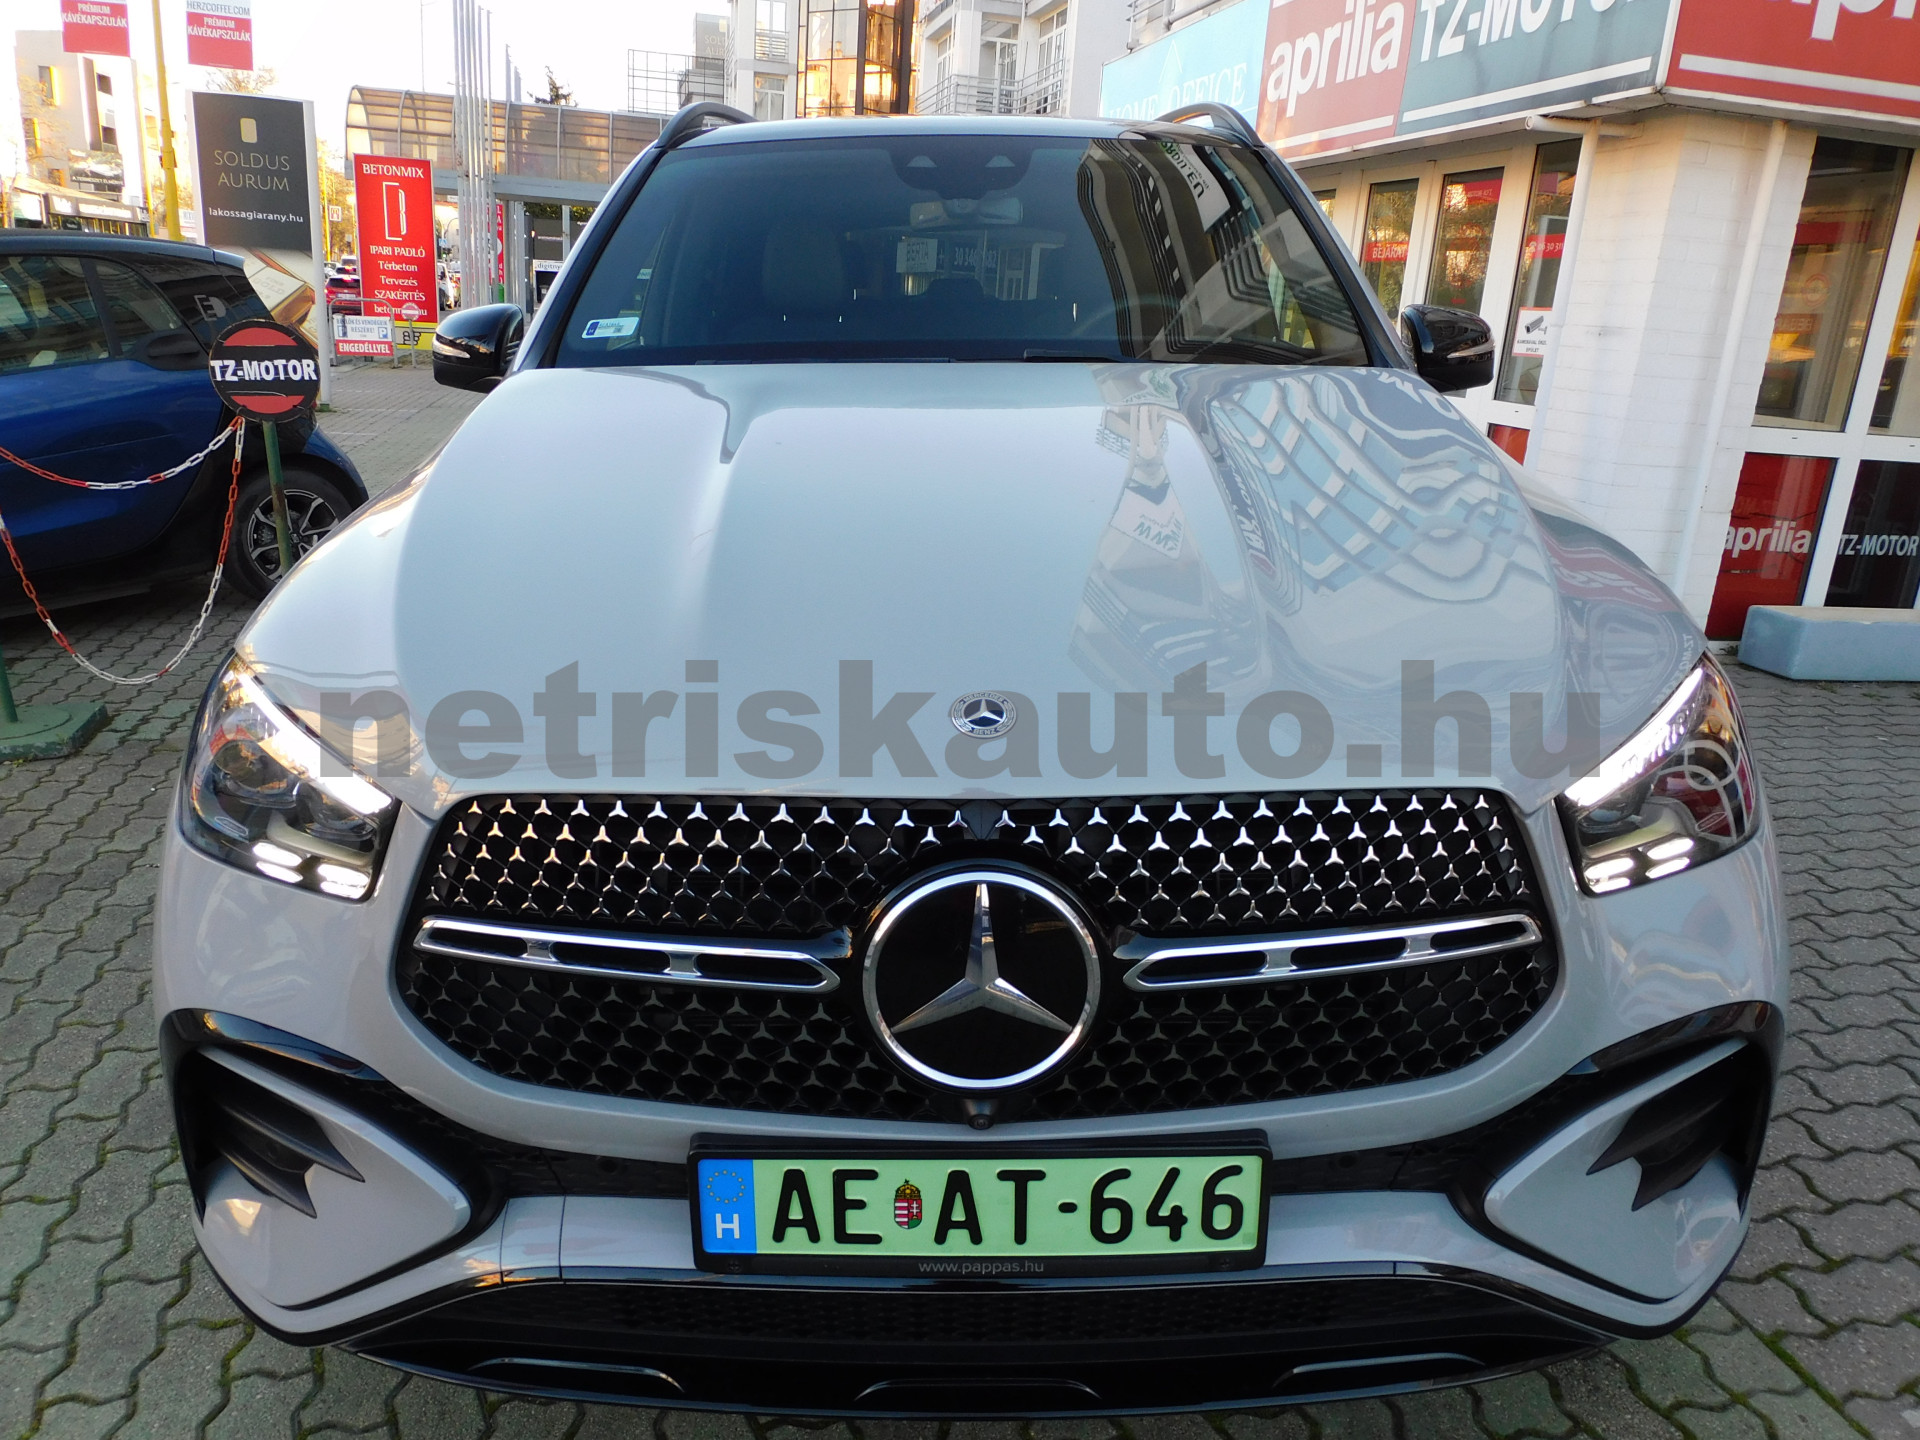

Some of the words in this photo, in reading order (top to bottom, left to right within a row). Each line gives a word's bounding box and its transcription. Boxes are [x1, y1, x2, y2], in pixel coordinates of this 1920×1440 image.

[78, 2, 110, 14] PRÉMIUM
[187, 0, 250, 16] HERZCOFFEE.COM
[62, 12, 127, 28] KÁVÉKAPSZULÁK
[203, 16, 235, 29] PRÉMIUM
[187, 25, 251, 42] KÁVÉKAPSZULÁK
[1266, 0, 1404, 118] aprilia
[214, 149, 290, 171] SOLDUS
[362, 163, 424, 179] BETONMIX
[218, 171, 290, 191] AURUM
[208, 207, 304, 223] lakossagiarany.hu
[369, 245, 392, 255] IPARI
[394, 245, 426, 258] PADLÓ
[1545, 242, 1555, 252] 30
[378, 260, 418, 272] Térbeton
[379, 275, 418, 287] Tervezés
[374, 289, 426, 301] SZAKÉRTÉS
[338, 342, 391, 354] ENGEDÉLLYEL
[210, 359, 317, 382] TZ-MOTOR
[1724, 520, 1812, 558] aprilia
[1838, 534, 1920, 557] TZ-MOTOR
[771, 1168, 883, 1245] AE
[934, 1164, 1245, 1246] AT-646
[715, 1213, 741, 1239] H
[918, 1261, 1045, 1276] www.pappas.hu
